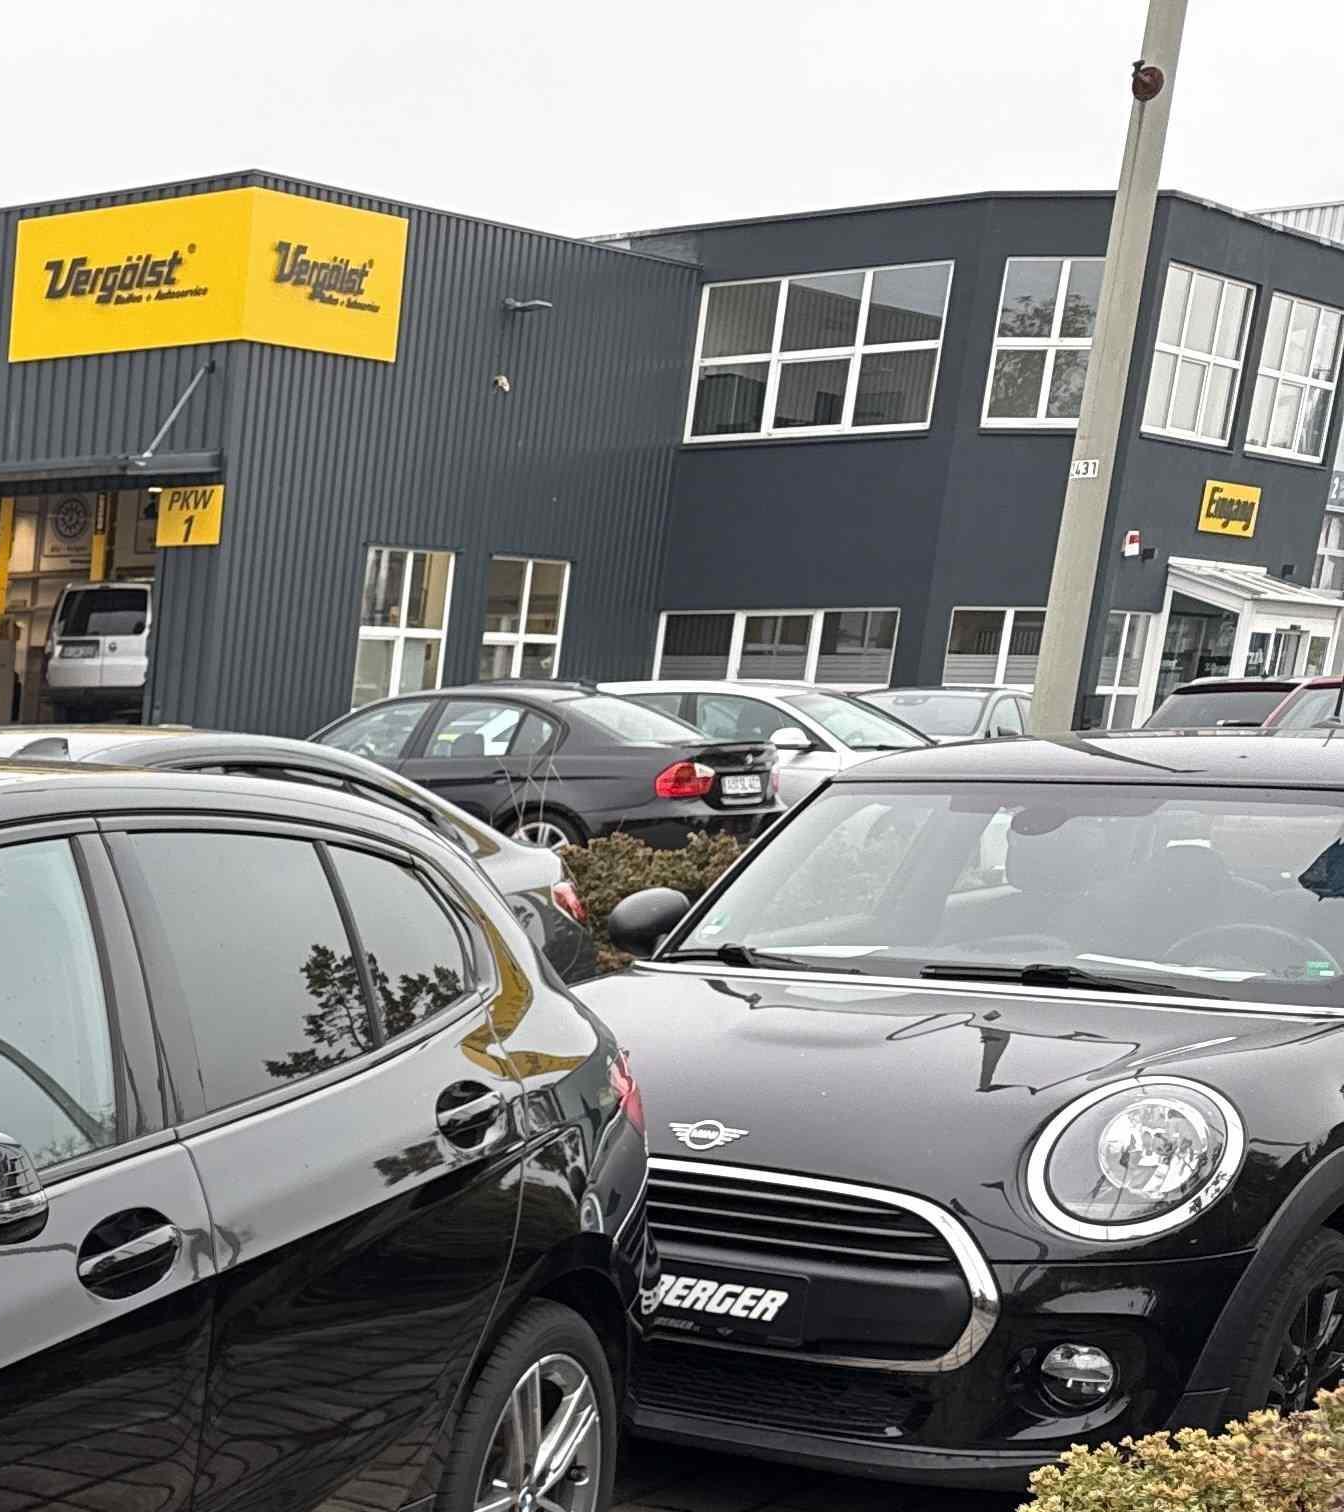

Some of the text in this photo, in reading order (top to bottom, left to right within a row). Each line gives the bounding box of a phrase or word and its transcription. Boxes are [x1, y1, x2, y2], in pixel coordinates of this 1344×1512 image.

[44, 250, 184, 305] Vergölst
[274, 240, 369, 300] Vergölst
[167, 490, 214, 511] PKW
[183, 517, 196, 543] 1
